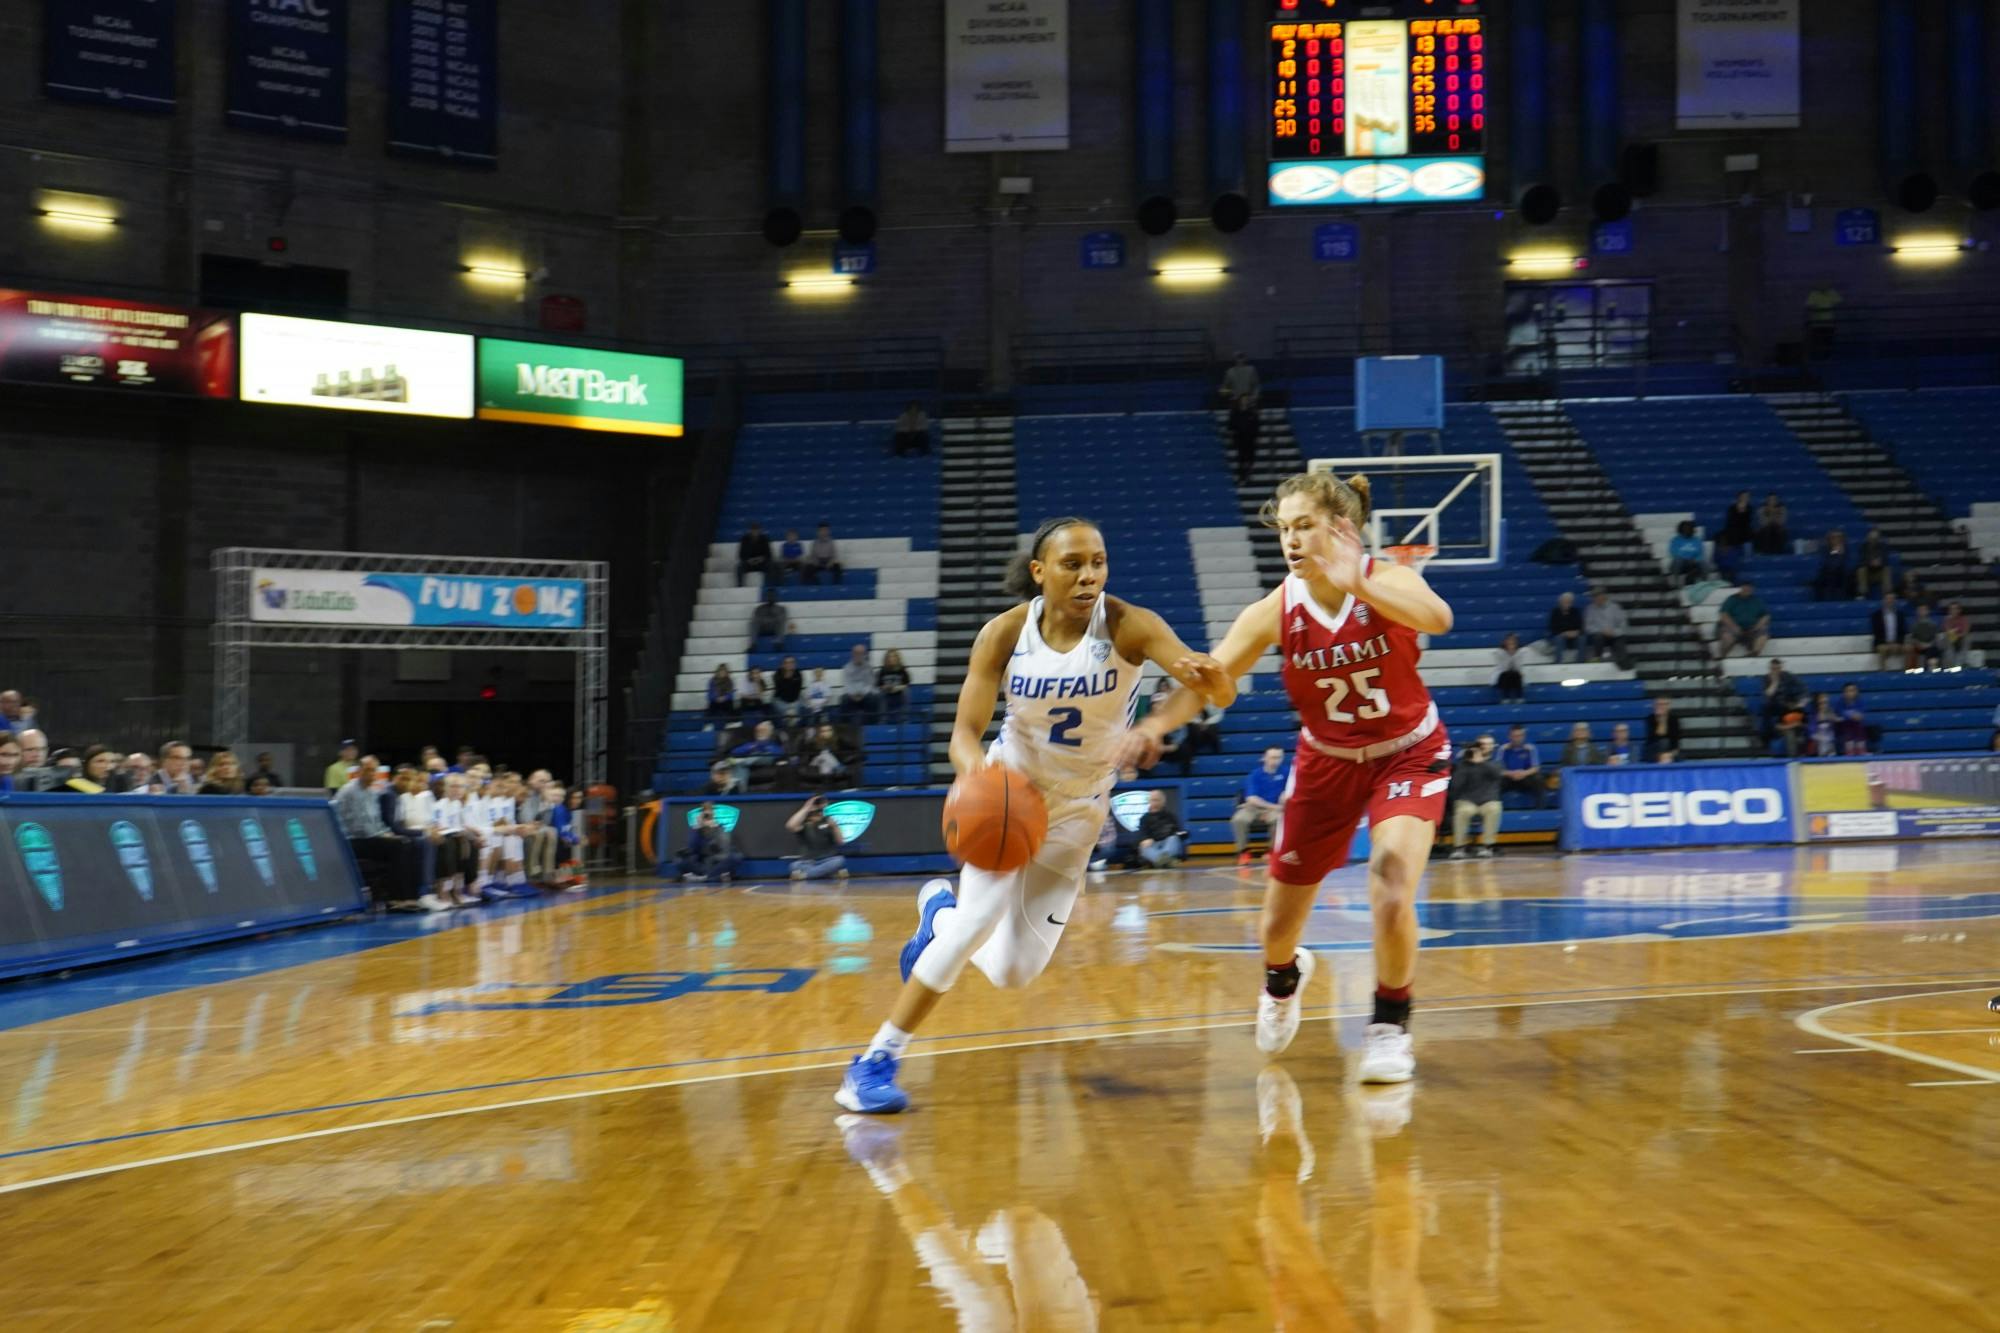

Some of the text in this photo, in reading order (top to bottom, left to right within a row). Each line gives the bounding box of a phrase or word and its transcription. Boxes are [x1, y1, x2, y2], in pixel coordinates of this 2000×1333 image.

[92, 14, 134, 29] NCAA
[248, 10, 331, 34] CHAMPIONS
[1690, 10, 1789, 23] TOURNAMENT
[66, 24, 160, 48] TOURNAMENT
[958, 32, 1058, 45] TOURNAMENT
[1416, 36, 1435, 54] 13
[1445, 35, 1459, 52] 0
[1469, 34, 1483, 51] 0
[271, 46, 308, 61] NCAA
[1281, 40, 1297, 58] 2
[1307, 39, 1320, 57] 0
[1330, 38, 1344, 57] 0
[246, 55, 332, 79] TOURNAMENT
[444, 60, 480, 74] NCAA
[1278, 58, 1344, 78] 10 0 3
[1411, 54, 1483, 73] 23 0 3
[444, 74, 480, 88] NCAA
[1279, 78, 1344, 97] 11 0 0
[1412, 73, 1483, 93] 25 0 0
[444, 88, 480, 103] NCAA
[972, 91, 1041, 101] VOLLEYBALL
[1414, 93, 1483, 113] 32 0 0
[444, 103, 481, 118] NCAA
[1274, 97, 1344, 117] 25 0 0
[1276, 117, 1345, 136] 30 0 0
[1415, 113, 1484, 132] 35 0 0
[1309, 138, 1321, 154] 0
[1449, 134, 1460, 150] 0
[1844, 227, 1873, 241] 121
[840, 256, 869, 271] 117
[516, 363, 648, 405] M&T Bank
[419, 577, 581, 619] FUN ZONE
[1291, 633, 1392, 671] MIAMI
[1010, 668, 1119, 699] BUFFALO
[1313, 667, 1392, 724] 25
[1047, 706, 1083, 747] 2
[1387, 780, 1414, 801] M
[1582, 788, 1784, 829] GEICO
